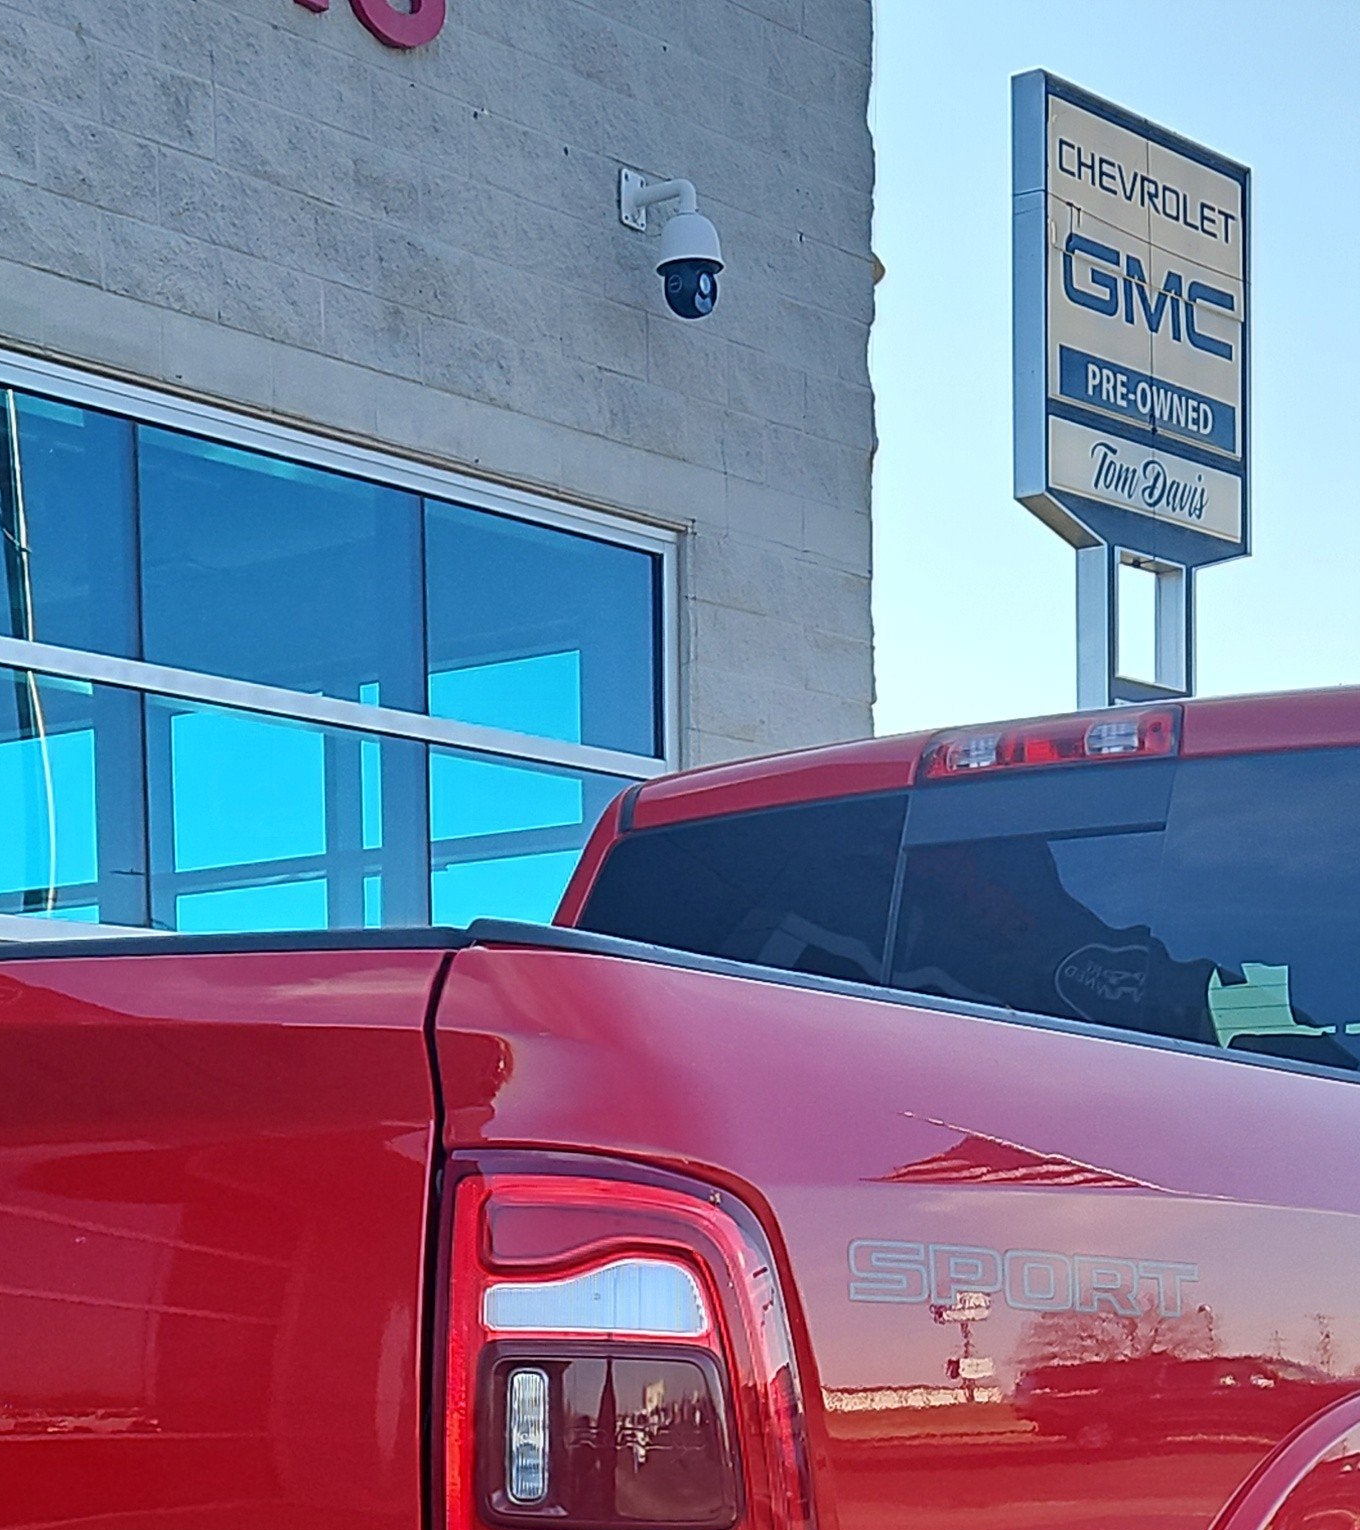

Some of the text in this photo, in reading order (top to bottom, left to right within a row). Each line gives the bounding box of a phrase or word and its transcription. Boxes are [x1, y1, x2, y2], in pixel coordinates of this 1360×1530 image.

[1059, 137, 1237, 244] CHEVROLET
[1061, 229, 1235, 361] GMC
[1086, 361, 1214, 437] PRE-OWNED
[1090, 441, 1209, 521] Tom Davis
[847, 1238, 1200, 1318] SPORT
